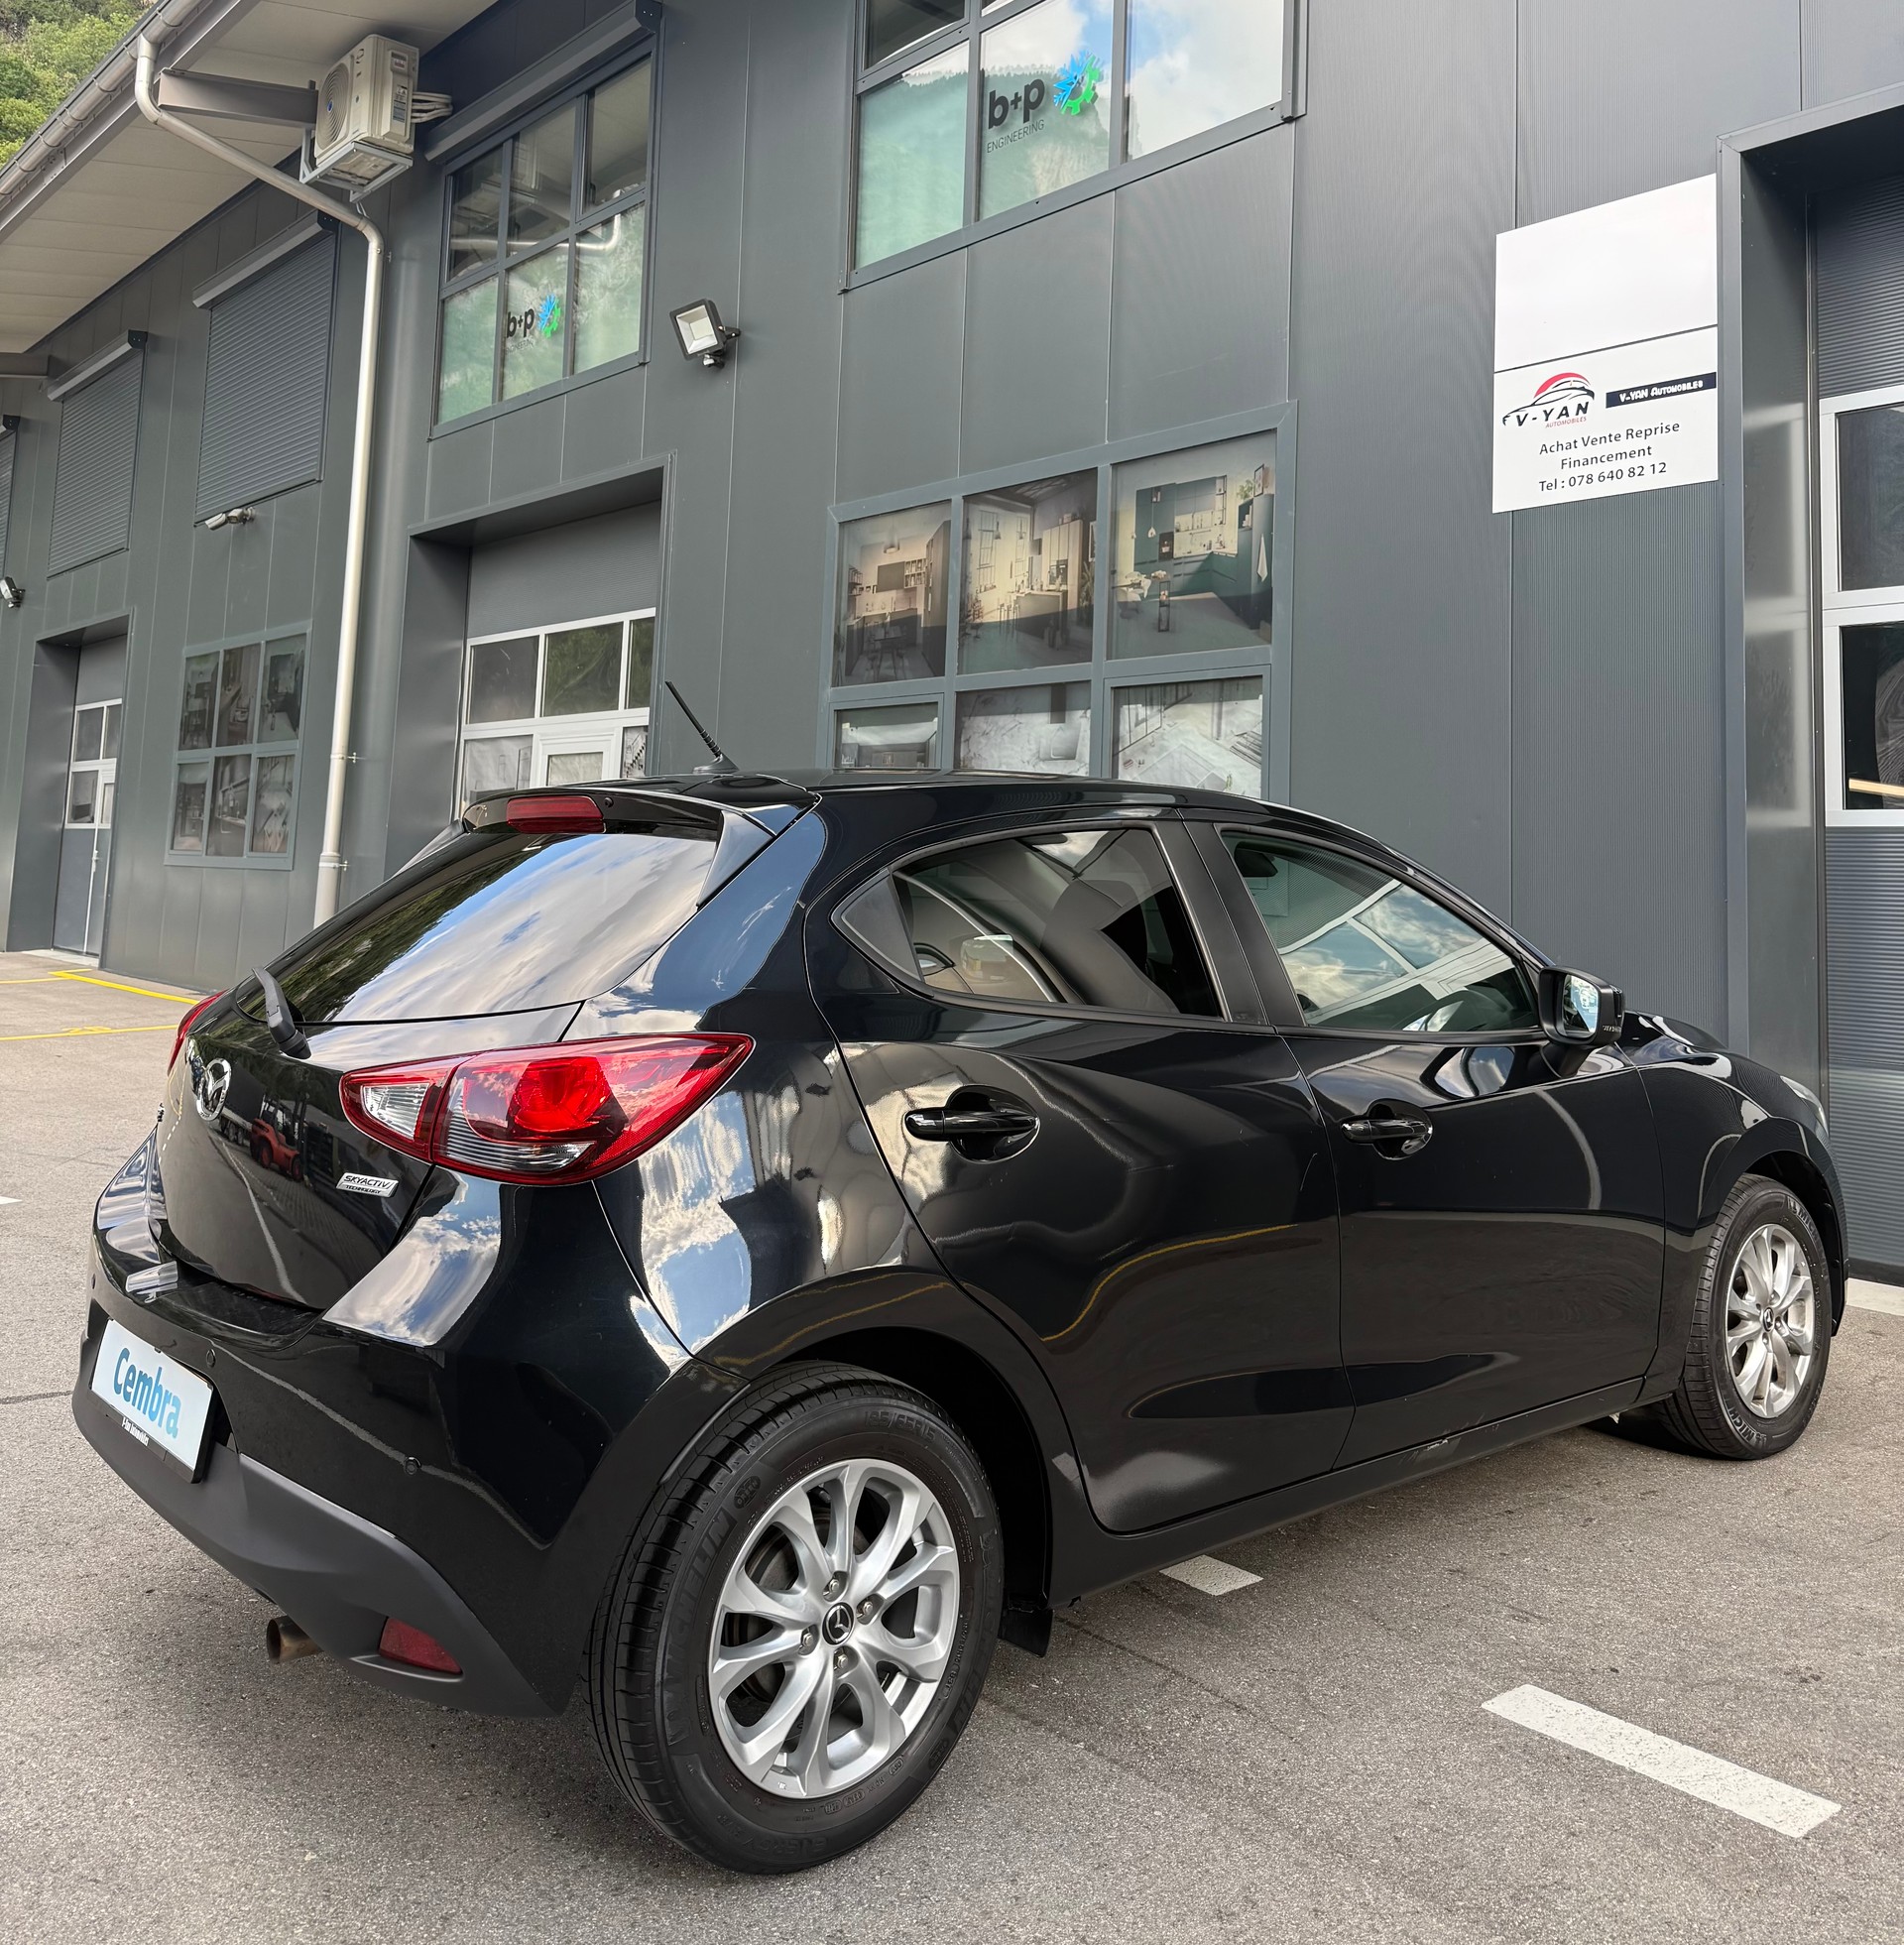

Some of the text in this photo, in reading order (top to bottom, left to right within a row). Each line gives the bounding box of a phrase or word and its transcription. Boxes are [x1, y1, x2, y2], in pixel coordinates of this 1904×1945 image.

[988, 78, 1045, 130] b+p
[987, 119, 1045, 154] ENGINEERING
[506, 307, 536, 338] b+p
[1618, 388, 1649, 403] V-YAN
[1515, 401, 1590, 427] V-YAN
[1545, 416, 1587, 428] AUTOMOBILES
[1539, 423, 1681, 455] Achat Vente Reprise
[1560, 445, 1653, 470] Financement
[1568, 473, 1594, 488] 078
[1598, 468, 1624, 483] 640
[1627, 465, 1645, 478] 82
[1649, 461, 1667, 475] 12
[343, 1174, 391, 1188] SKYACTIV
[113, 1347, 182, 1439] Cembra
